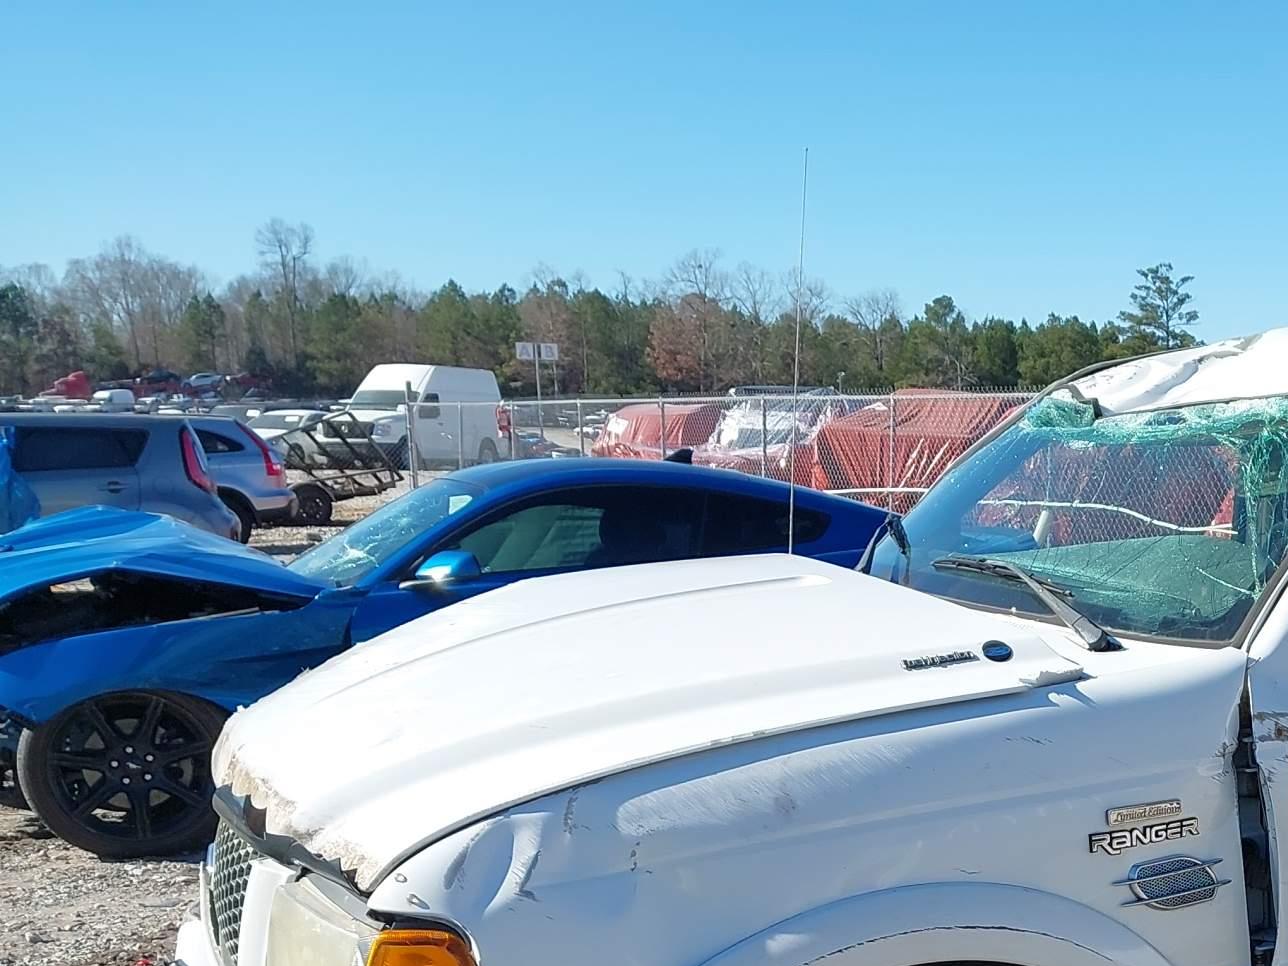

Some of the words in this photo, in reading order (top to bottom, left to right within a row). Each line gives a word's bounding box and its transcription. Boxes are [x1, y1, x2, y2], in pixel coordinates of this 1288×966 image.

[519, 344, 532, 358] A
[1113, 809, 1147, 823] Limited
[1089, 817, 1200, 855] RANGER
